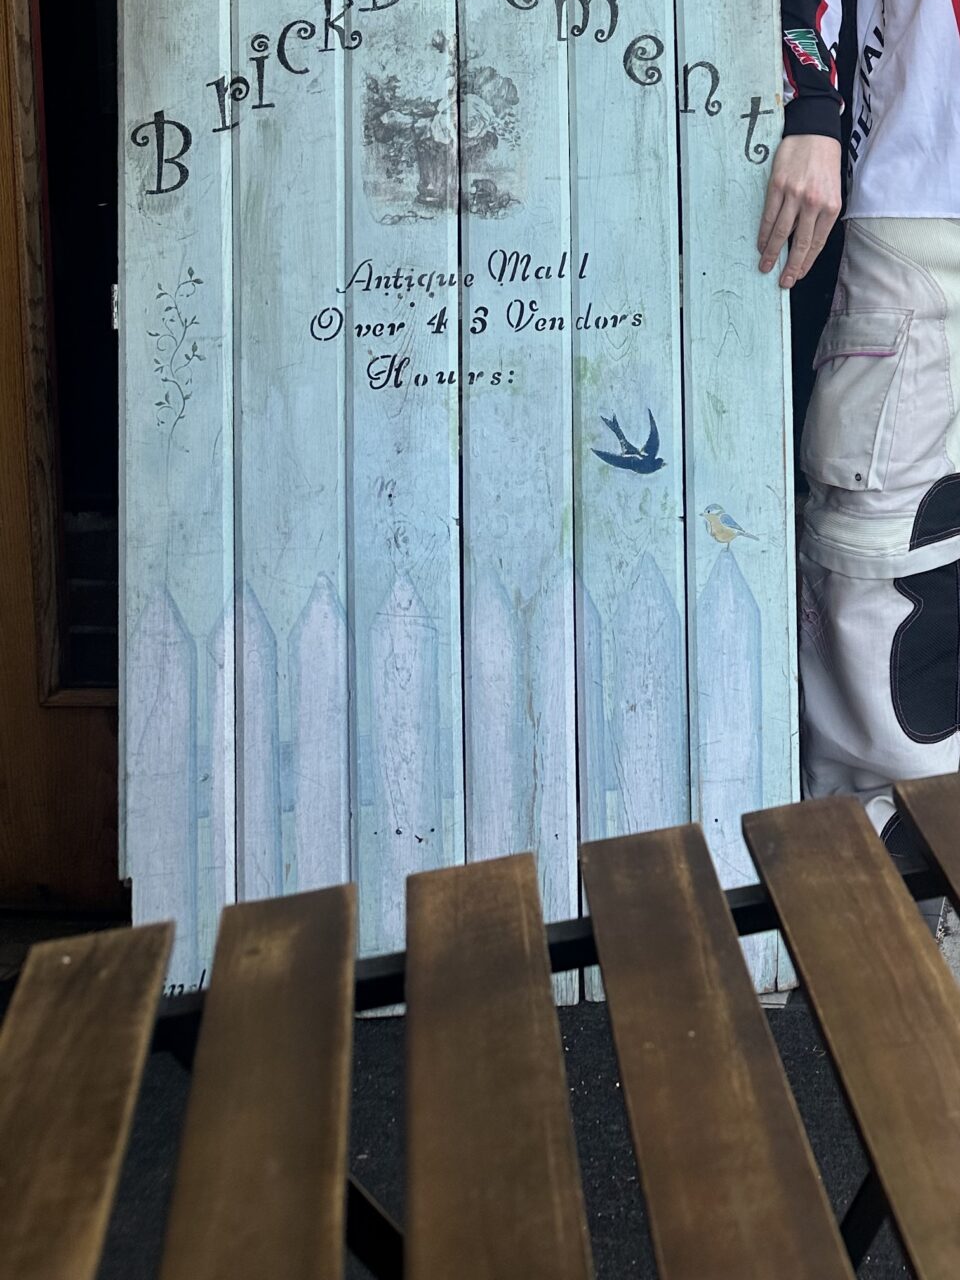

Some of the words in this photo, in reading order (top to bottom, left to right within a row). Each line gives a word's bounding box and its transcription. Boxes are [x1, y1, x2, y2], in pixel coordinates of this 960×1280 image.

[336, 259, 475, 293] Antique
[488, 250, 590, 284] Mall
[311, 307, 405, 341] Over
[507, 299, 643, 333] Vendors
[367, 354, 515, 389] Hours:
